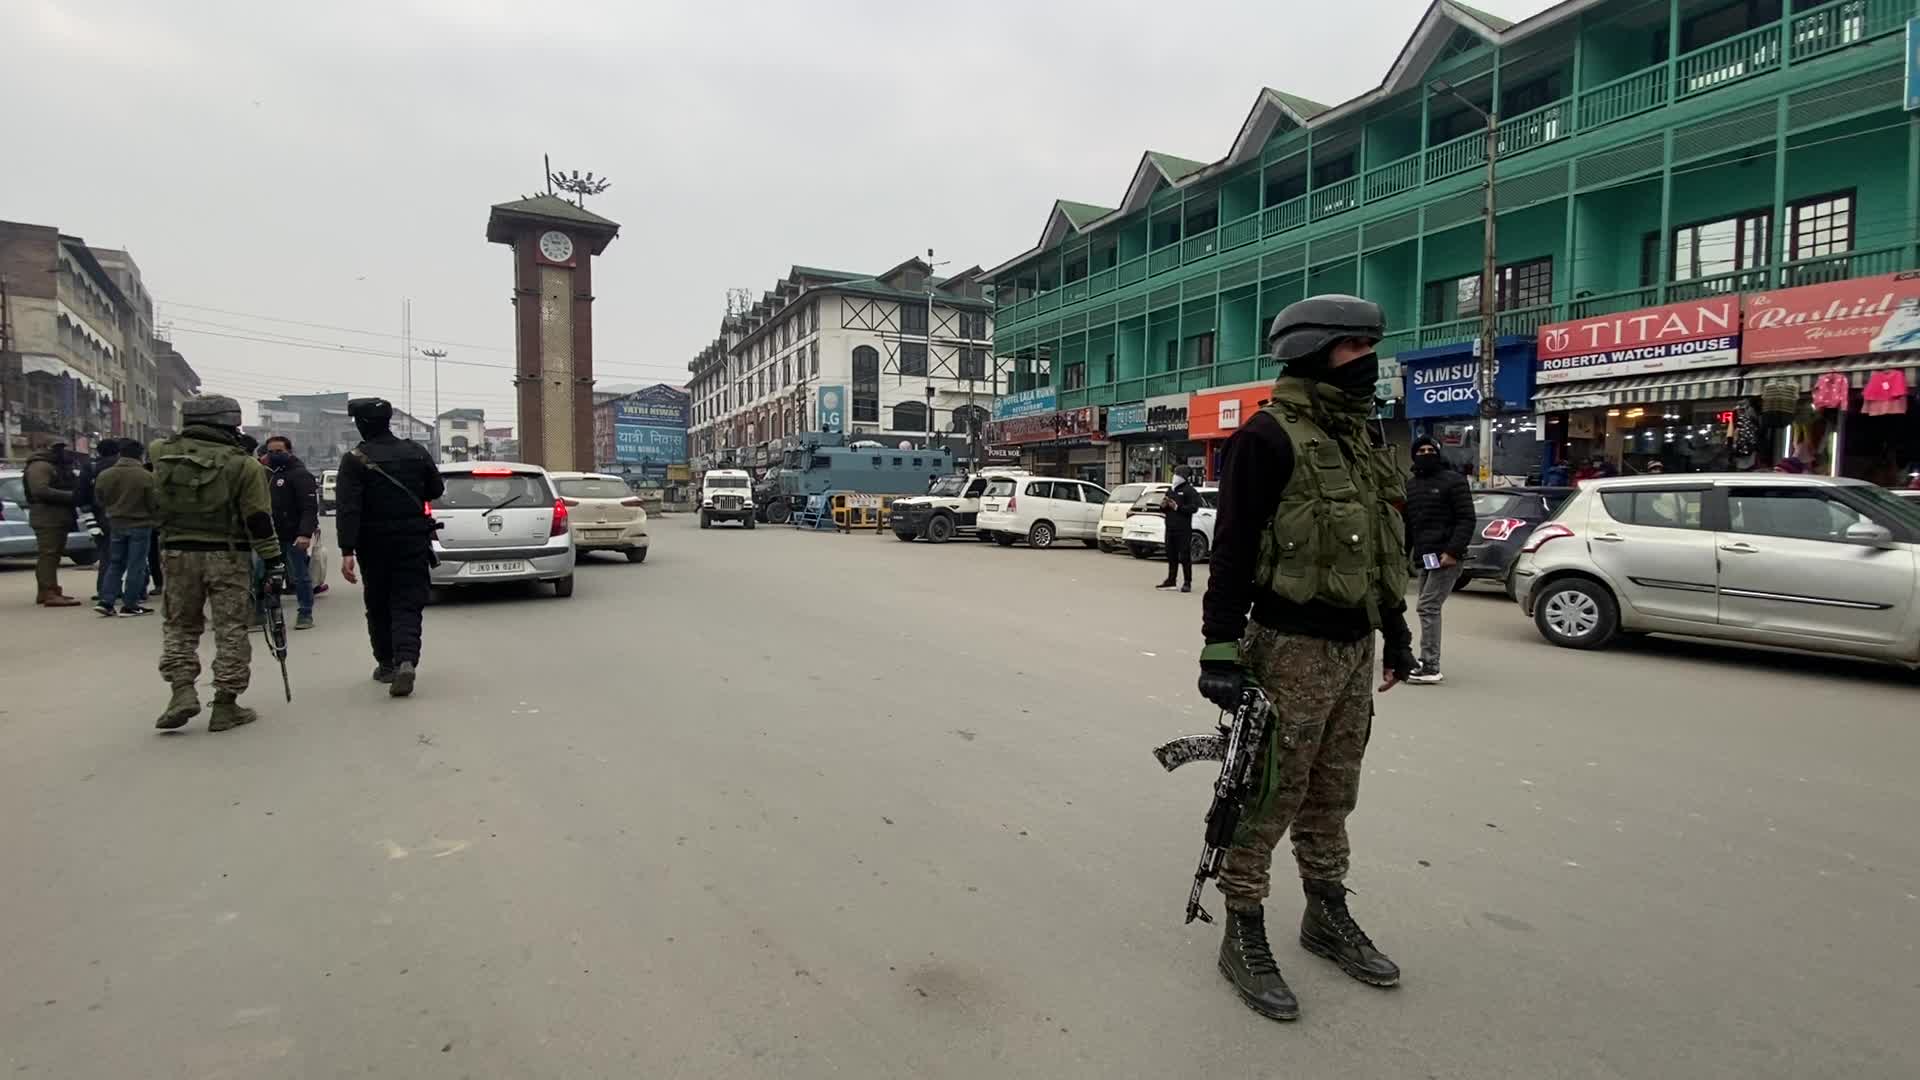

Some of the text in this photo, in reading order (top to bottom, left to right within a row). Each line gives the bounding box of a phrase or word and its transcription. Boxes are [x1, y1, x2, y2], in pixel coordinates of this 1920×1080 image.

[1749, 293, 1895, 329] Rashid
[1581, 303, 1731, 348] TITAN
[1543, 337, 1731, 370] ROBERTA WATCH HOUSE
[1413, 360, 1500, 385] SAMSUG
[1423, 387, 1482, 404] Galaxy
[822, 411, 840, 425] LG
[1147, 405, 1188, 423] Nikon
[618, 429, 643, 443] यात्री
[1167, 423, 1188, 431] STUDIO
